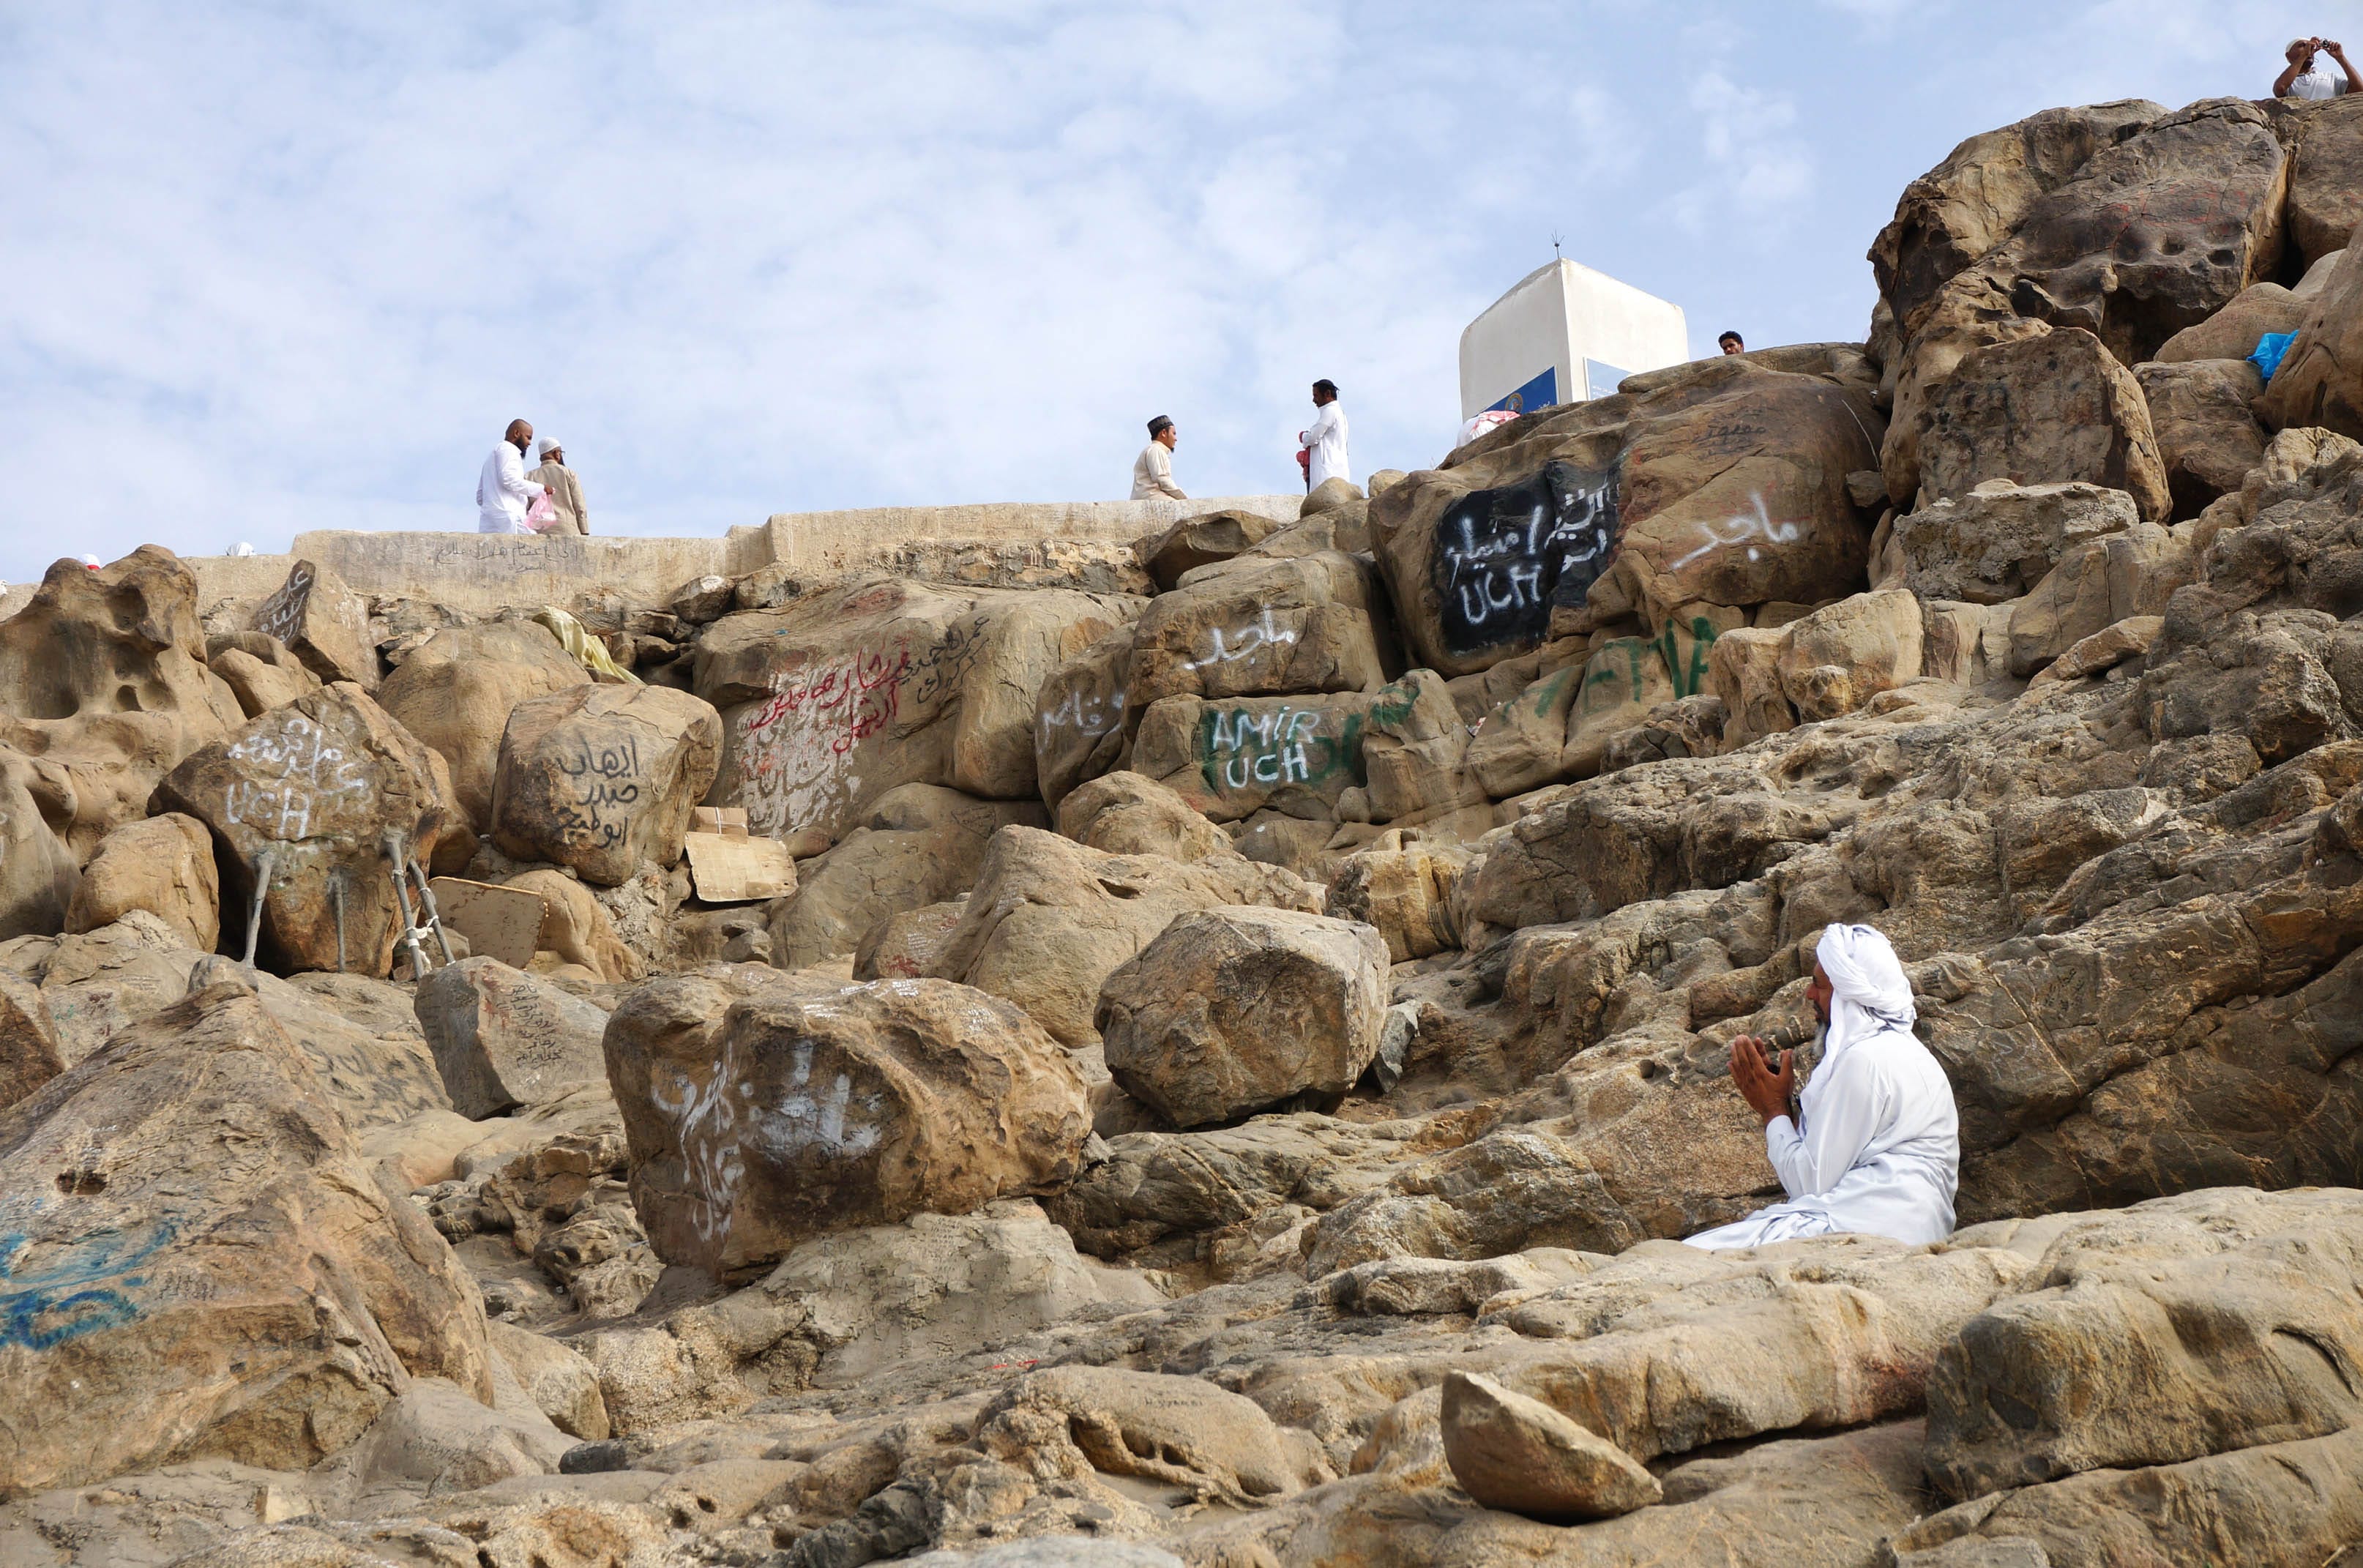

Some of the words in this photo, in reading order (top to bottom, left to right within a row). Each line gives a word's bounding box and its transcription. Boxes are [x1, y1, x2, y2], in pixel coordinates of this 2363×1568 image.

[1460, 562, 1544, 624] UCH
[1212, 705, 1321, 753] AMIR
[1225, 742, 1310, 789] UCH
[576, 783, 639, 808] حيدر
